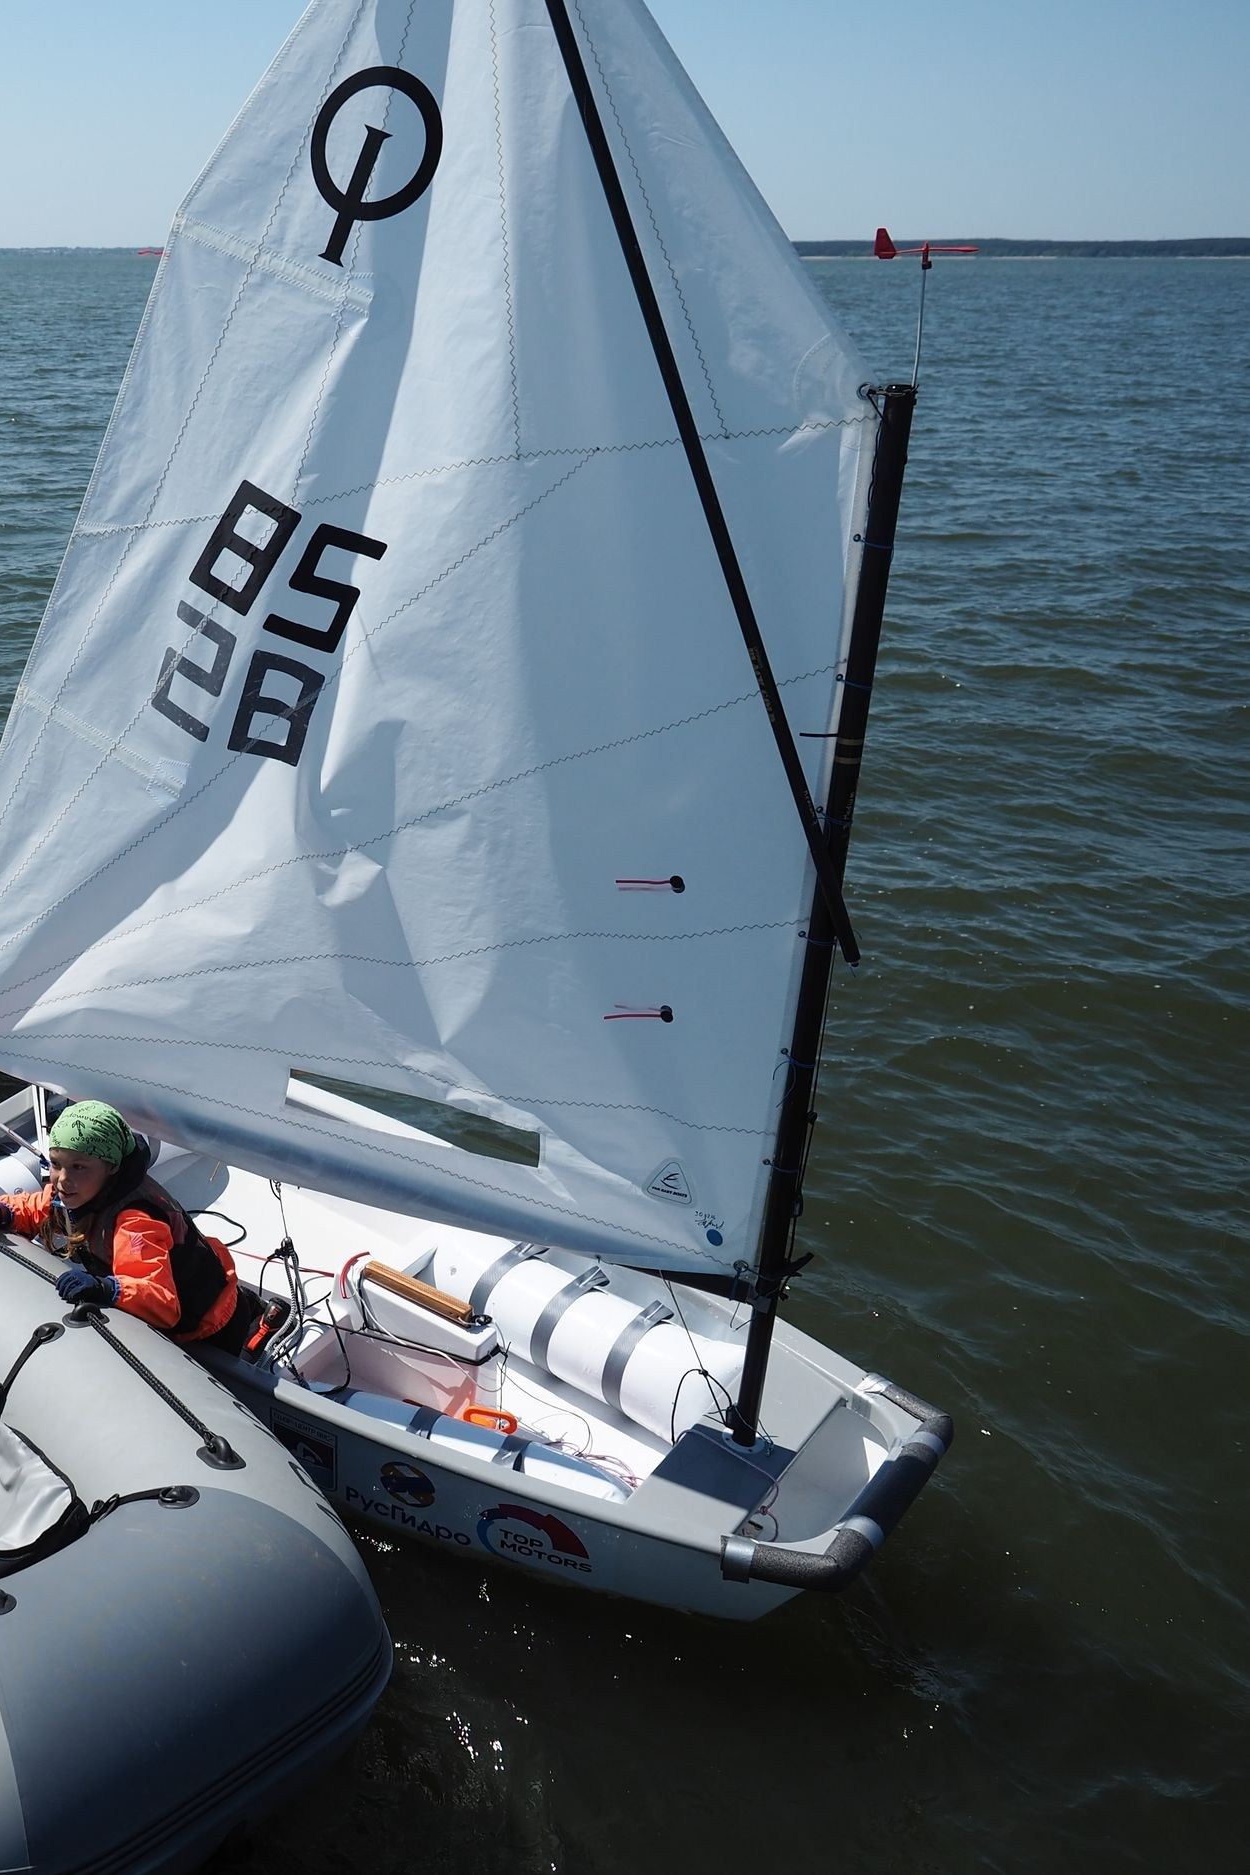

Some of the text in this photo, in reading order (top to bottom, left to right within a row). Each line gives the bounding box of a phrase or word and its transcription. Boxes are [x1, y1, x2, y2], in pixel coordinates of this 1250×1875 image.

[189, 480, 388, 654] 85
[345, 1485, 472, 1548] РусГидро
[499, 1527, 544, 1549] TOP
[499, 1540, 594, 1574] MOTORS
